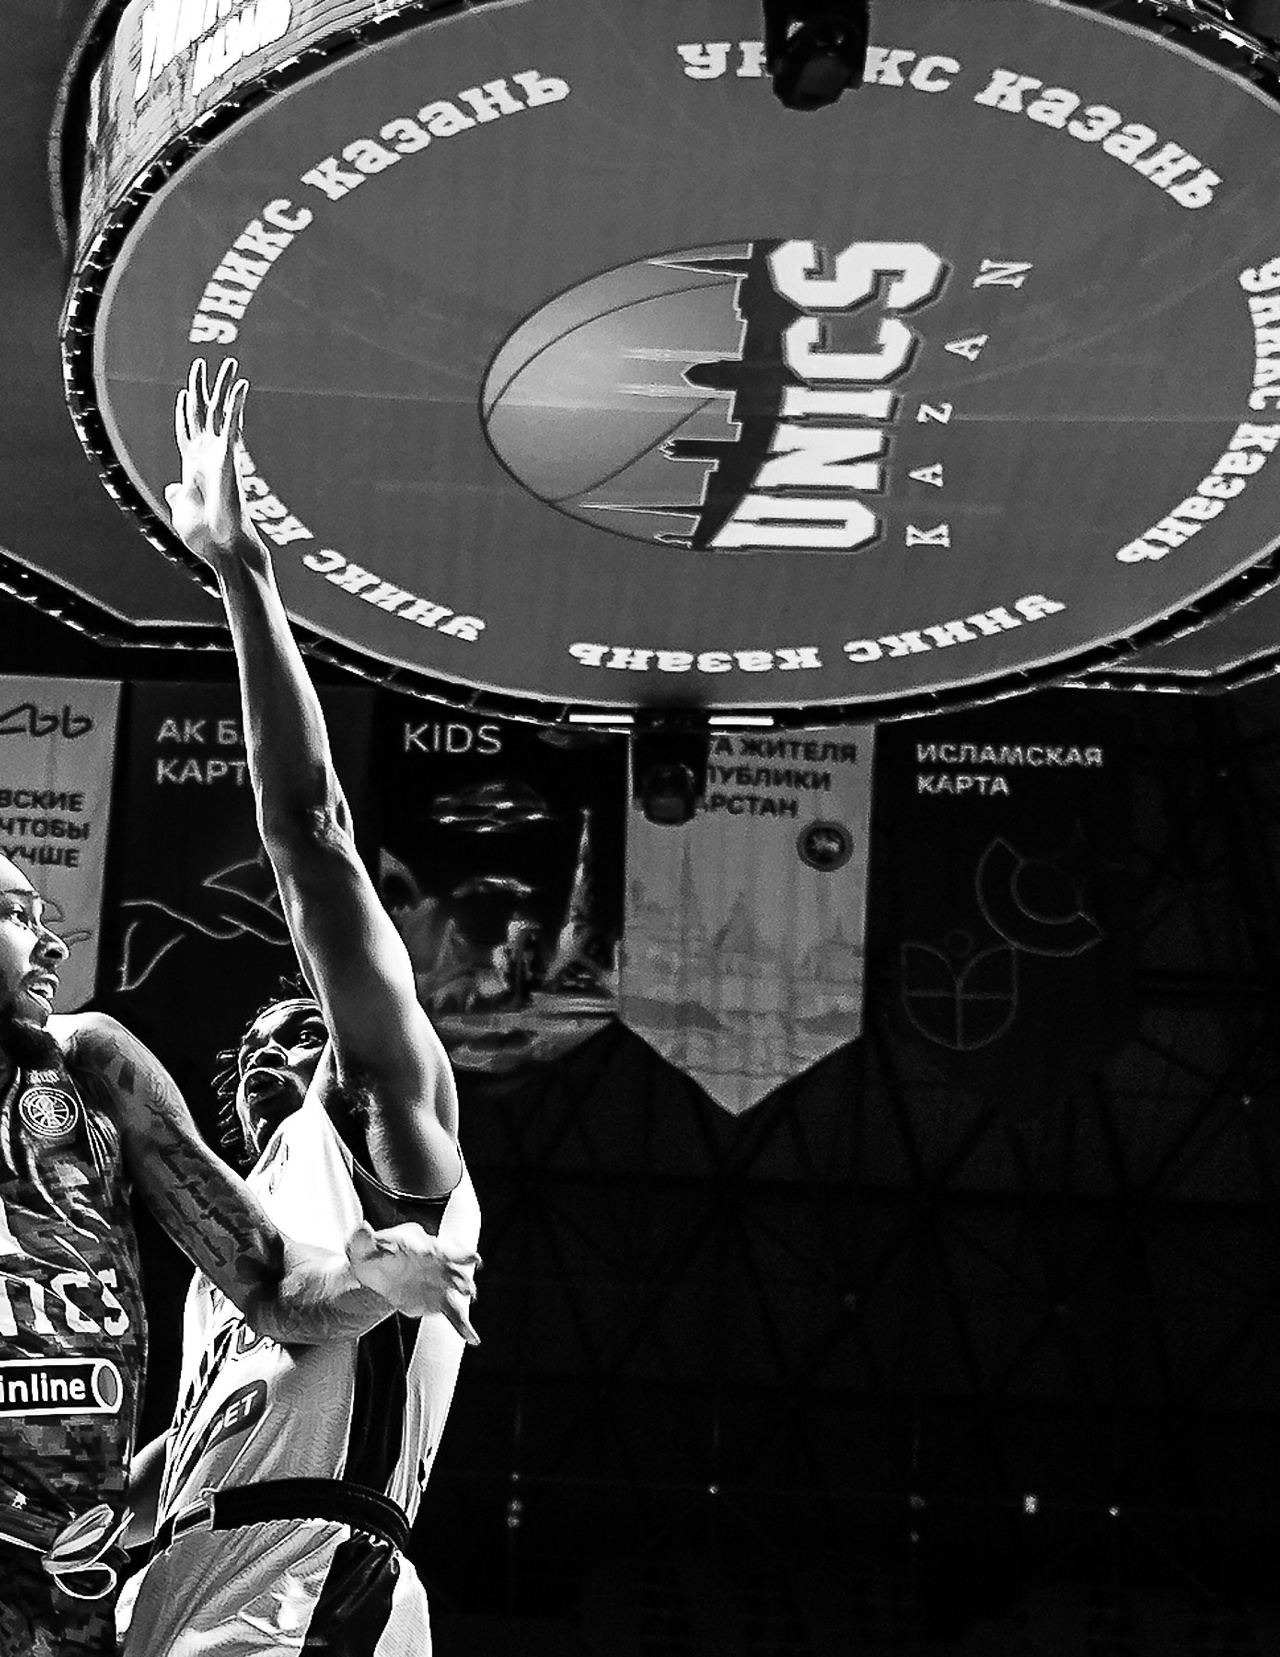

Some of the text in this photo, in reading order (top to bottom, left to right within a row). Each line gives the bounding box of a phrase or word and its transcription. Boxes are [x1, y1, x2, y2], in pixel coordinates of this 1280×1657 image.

[708, 237, 946, 551] UNICS
[156, 718, 205, 744] АК
[404, 722, 503, 754] KIDS
[739, 738, 858, 764] ЖИТЕЛЯ
[916, 743, 1104, 767] ИСЛАМСКАЯ
[156, 758, 248, 785] КАРТ
[916, 773, 1011, 797] КАРТА
[2, 845, 80, 868] УЧШЕ
